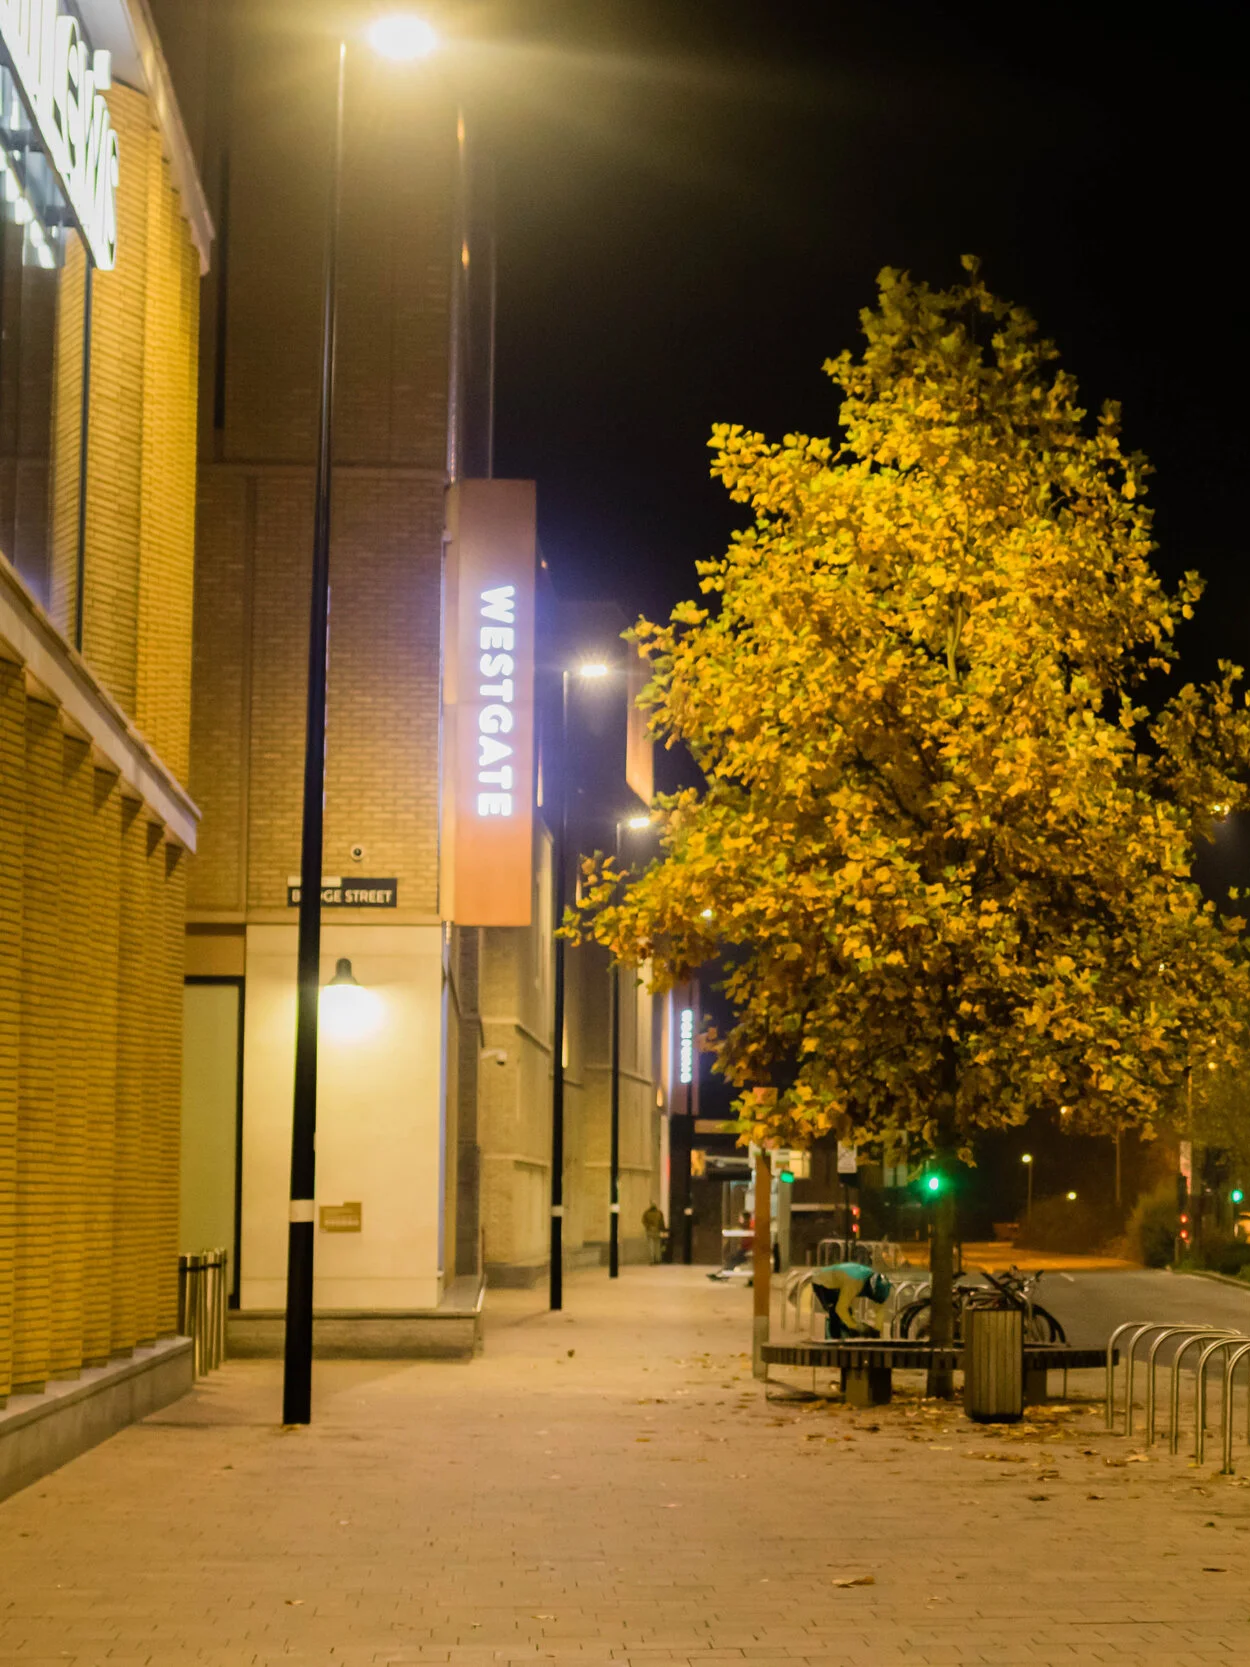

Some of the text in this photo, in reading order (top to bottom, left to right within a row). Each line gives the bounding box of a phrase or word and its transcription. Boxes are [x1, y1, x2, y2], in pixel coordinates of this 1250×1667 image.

[478, 586, 515, 816] WESTGATE
[292, 889, 392, 903] BGE STREET
